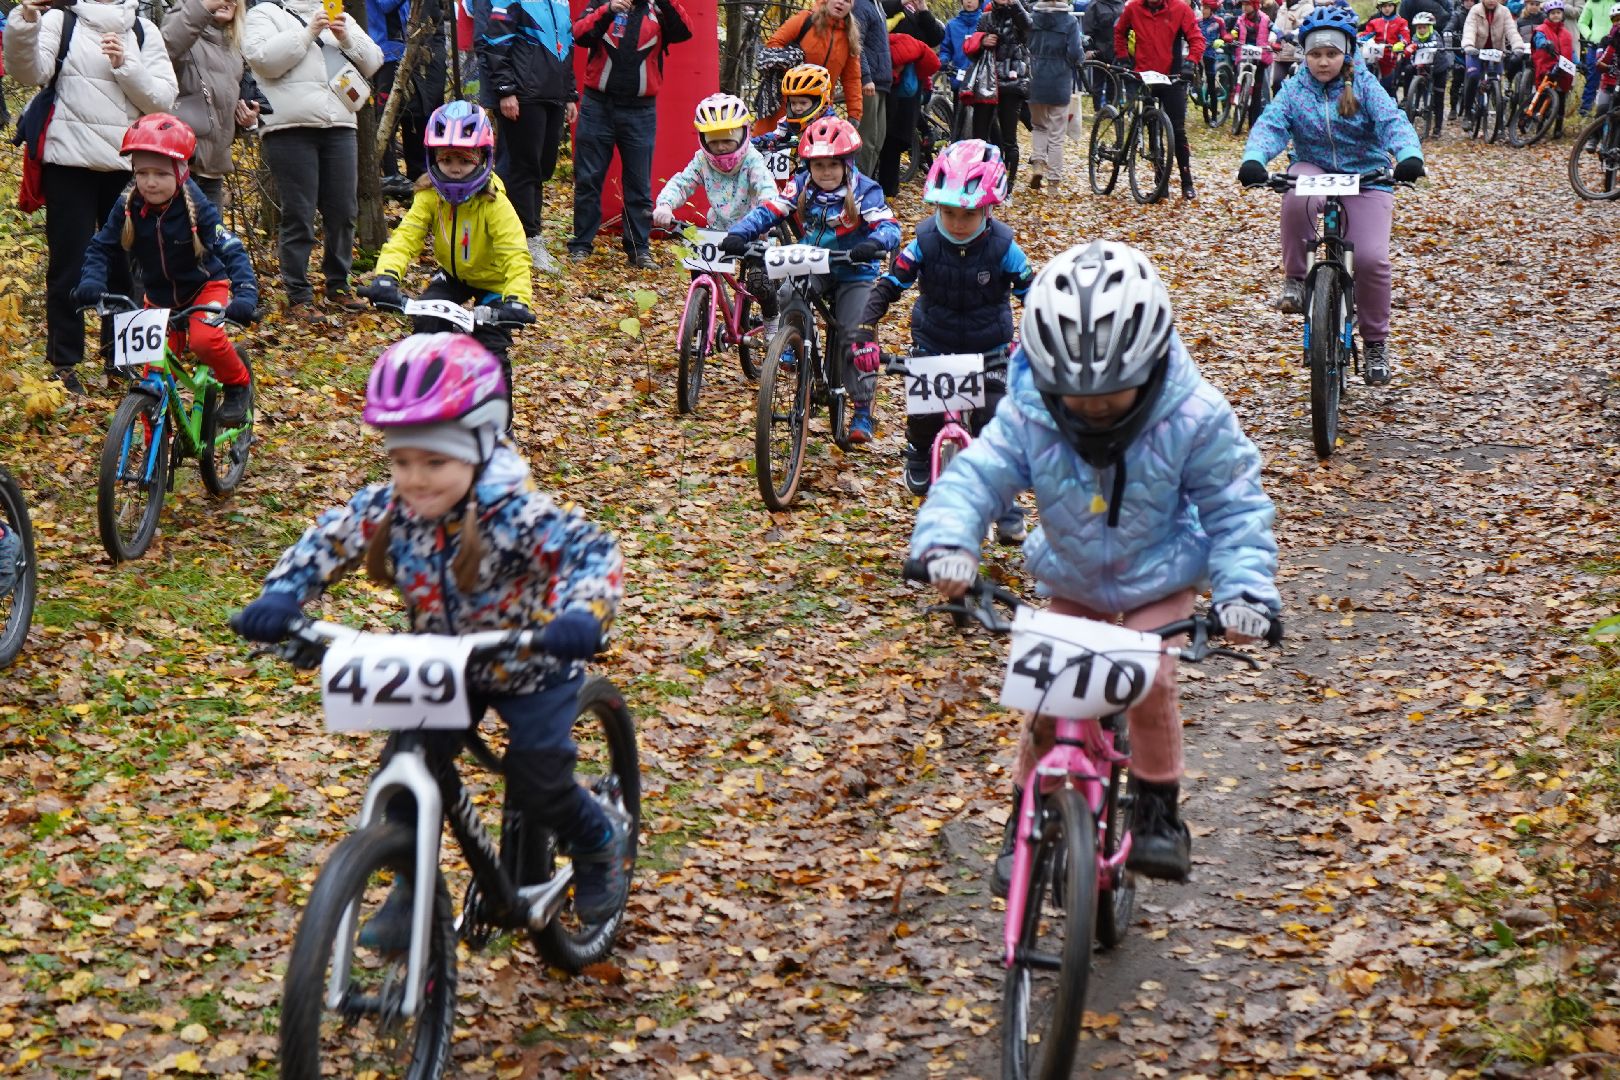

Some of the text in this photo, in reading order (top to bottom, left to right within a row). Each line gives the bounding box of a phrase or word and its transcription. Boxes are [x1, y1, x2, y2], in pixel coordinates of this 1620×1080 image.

[117, 324, 162, 354] 156
[908, 371, 982, 401] 404
[328, 656, 457, 706] 429
[1012, 641, 1146, 705] 410
